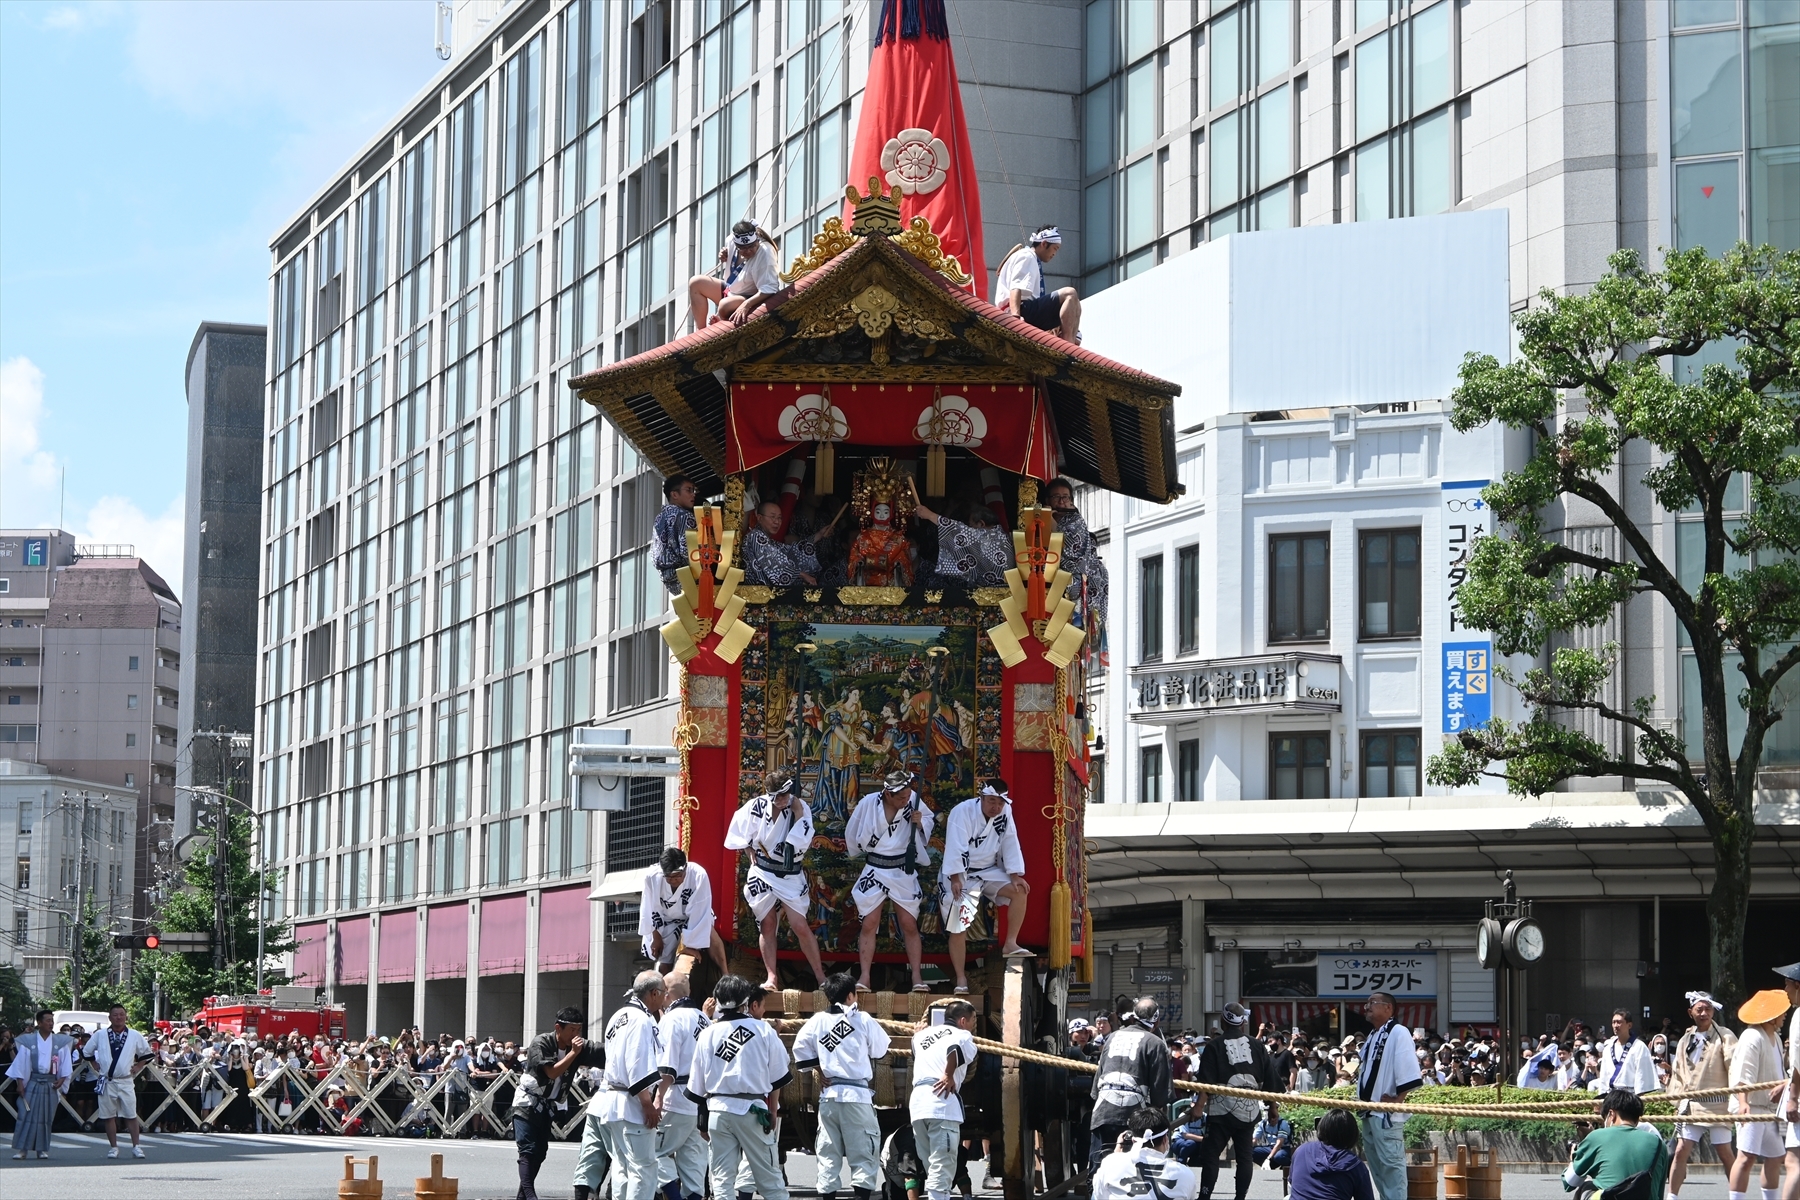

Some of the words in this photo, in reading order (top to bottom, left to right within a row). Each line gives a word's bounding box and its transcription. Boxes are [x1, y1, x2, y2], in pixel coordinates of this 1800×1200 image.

[1137, 667, 1286, 708] 池善化粧品店
[1446, 650, 1465, 731] 買えます
[1467, 651, 1485, 692] すぐ
[1333, 972, 1422, 991] コンタクト
[1362, 959, 1422, 969] メガネスーパー
